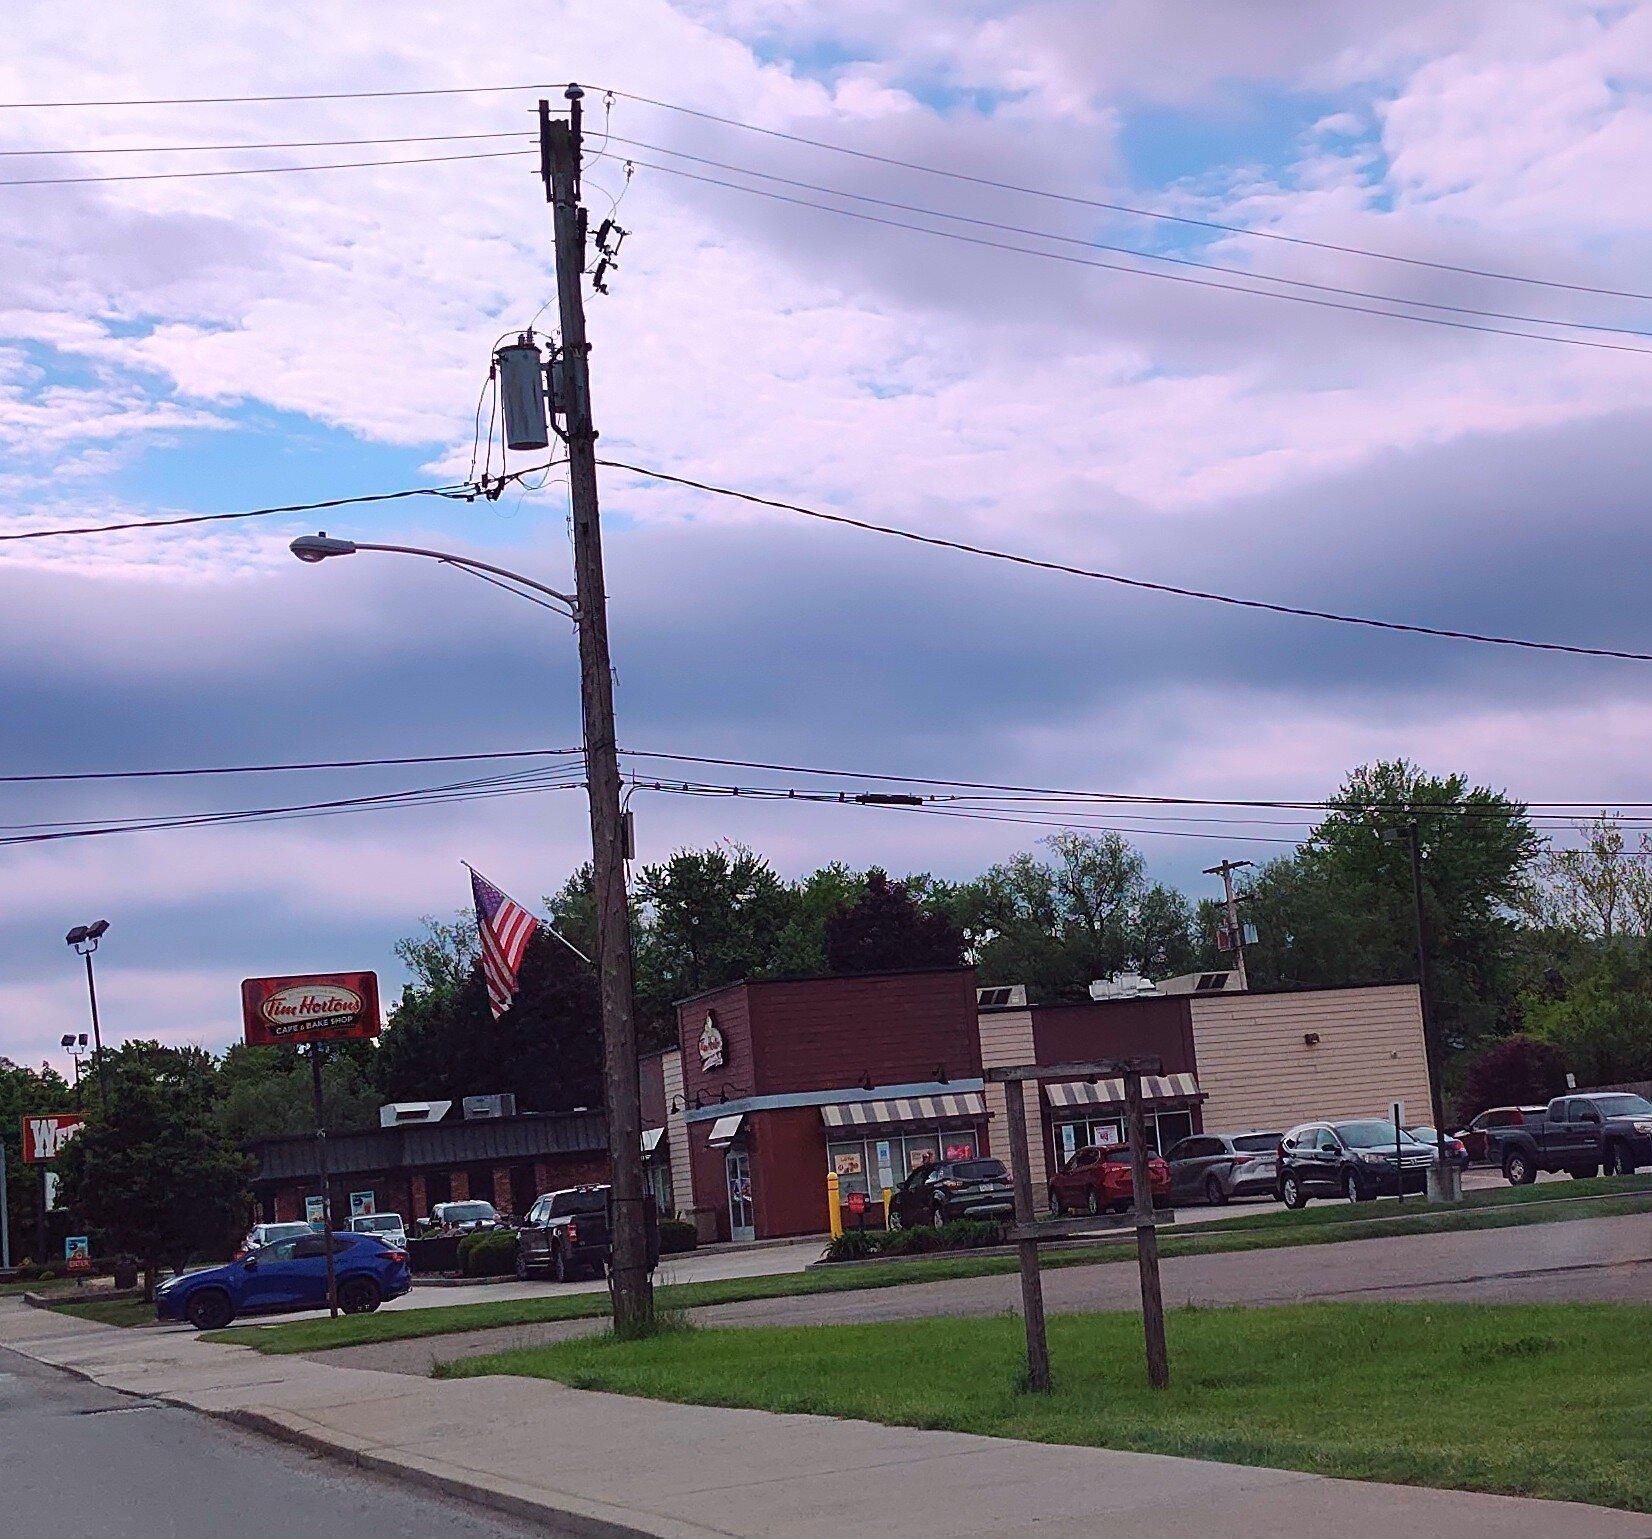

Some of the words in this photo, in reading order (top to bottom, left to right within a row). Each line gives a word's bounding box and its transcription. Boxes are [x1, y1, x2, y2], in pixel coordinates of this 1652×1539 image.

[265, 997, 297, 1016] Tim
[299, 995, 360, 1015] Hortons
[306, 1020, 328, 1030] BAKE
[331, 1015, 353, 1026] SHOP
